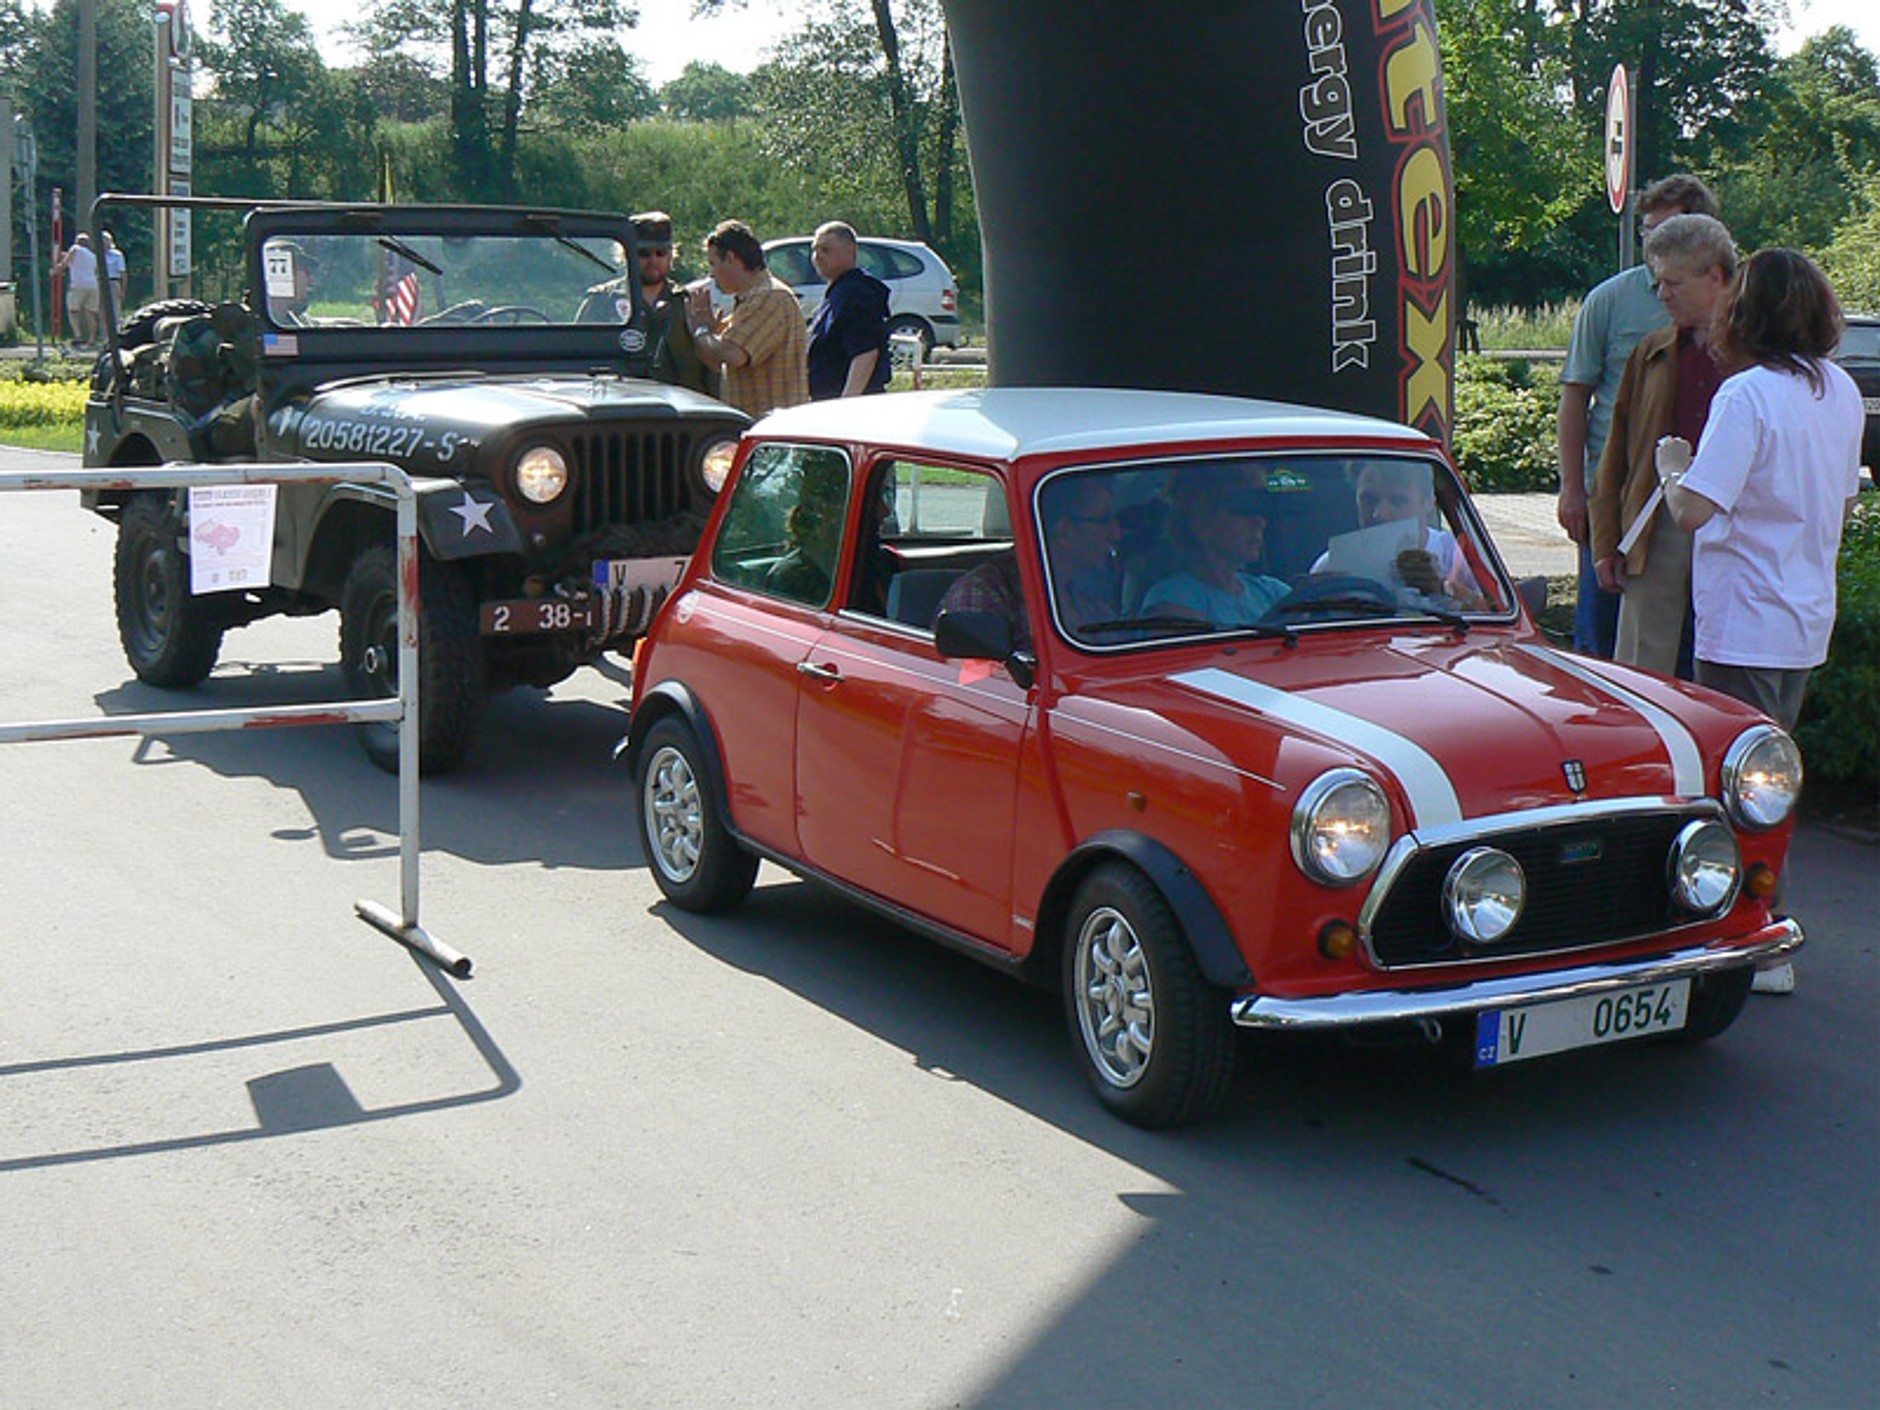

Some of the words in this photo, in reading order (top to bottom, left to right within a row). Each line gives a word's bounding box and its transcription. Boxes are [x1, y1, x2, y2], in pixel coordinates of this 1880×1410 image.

[1373, 0, 1450, 428] tex
[1325, 178, 1377, 374] drink
[305, 420, 458, 462] 20581227-S
[493, 606, 511, 632] 2
[1508, 1012, 1527, 1055] V
[1593, 986, 1672, 1038] 0654
